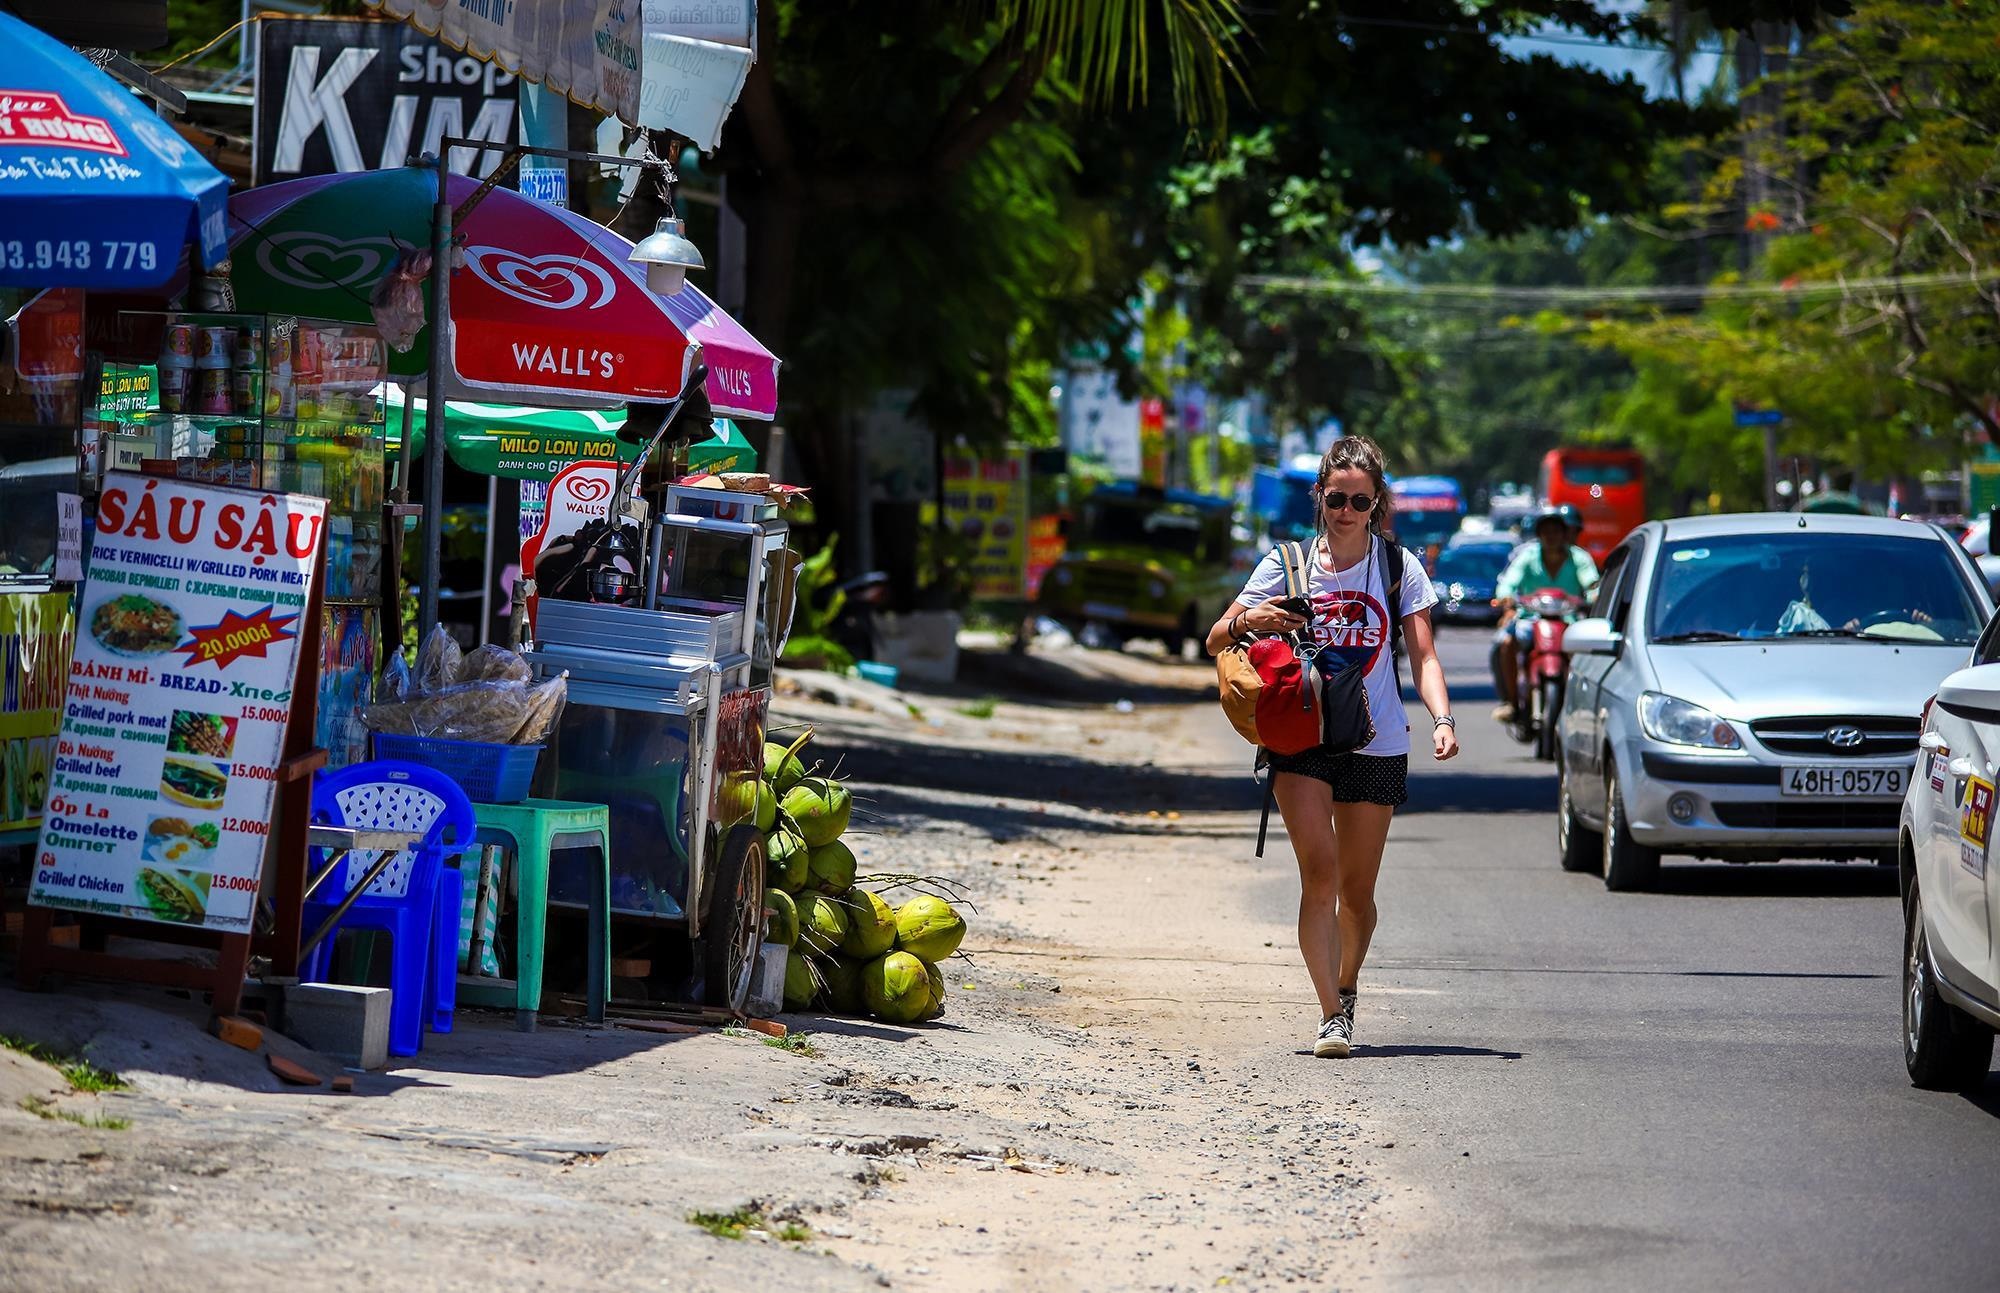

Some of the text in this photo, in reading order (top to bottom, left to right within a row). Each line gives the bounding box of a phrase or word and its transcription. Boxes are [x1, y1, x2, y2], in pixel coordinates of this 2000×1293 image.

[399, 44, 515, 95] Shop
[102, 241, 157, 270] 779
[511, 342, 614, 379] WALL'S
[500, 437, 617, 457] MILO LON MỚI
[526, 461, 546, 470] CHO
[566, 502, 606, 516] WALL'S
[96, 480, 322, 566] SÁU SẬU
[92, 546, 117, 561] RICE
[119, 549, 184, 570] VERMICELLI
[186, 559, 247, 579] W/GRILLED
[249, 566, 278, 583] PORK
[281, 572, 311, 587] MEAT
[88, 567, 127, 585] РИСОВАЯ
[192, 582, 238, 599] ЖАРЕНЫМ
[239, 586, 275, 603] СВИНЫМ
[199, 622, 273, 660] 20.000đ
[1314, 626, 1381, 648] evi's
[71, 660, 122, 682] BÁNH
[68, 682, 90, 700] Thịt
[68, 703, 167, 729] Grilled pork meat
[58, 741, 74, 756] Bò
[56, 757, 121, 778] Grilled beef
[1790, 770, 1901, 793] 48H-0579
[50, 794, 110, 819] Ốp La
[50, 817, 139, 841] Omelette
[41, 851, 57, 867] Gà
[39, 869, 125, 894] Grilled Chicken
